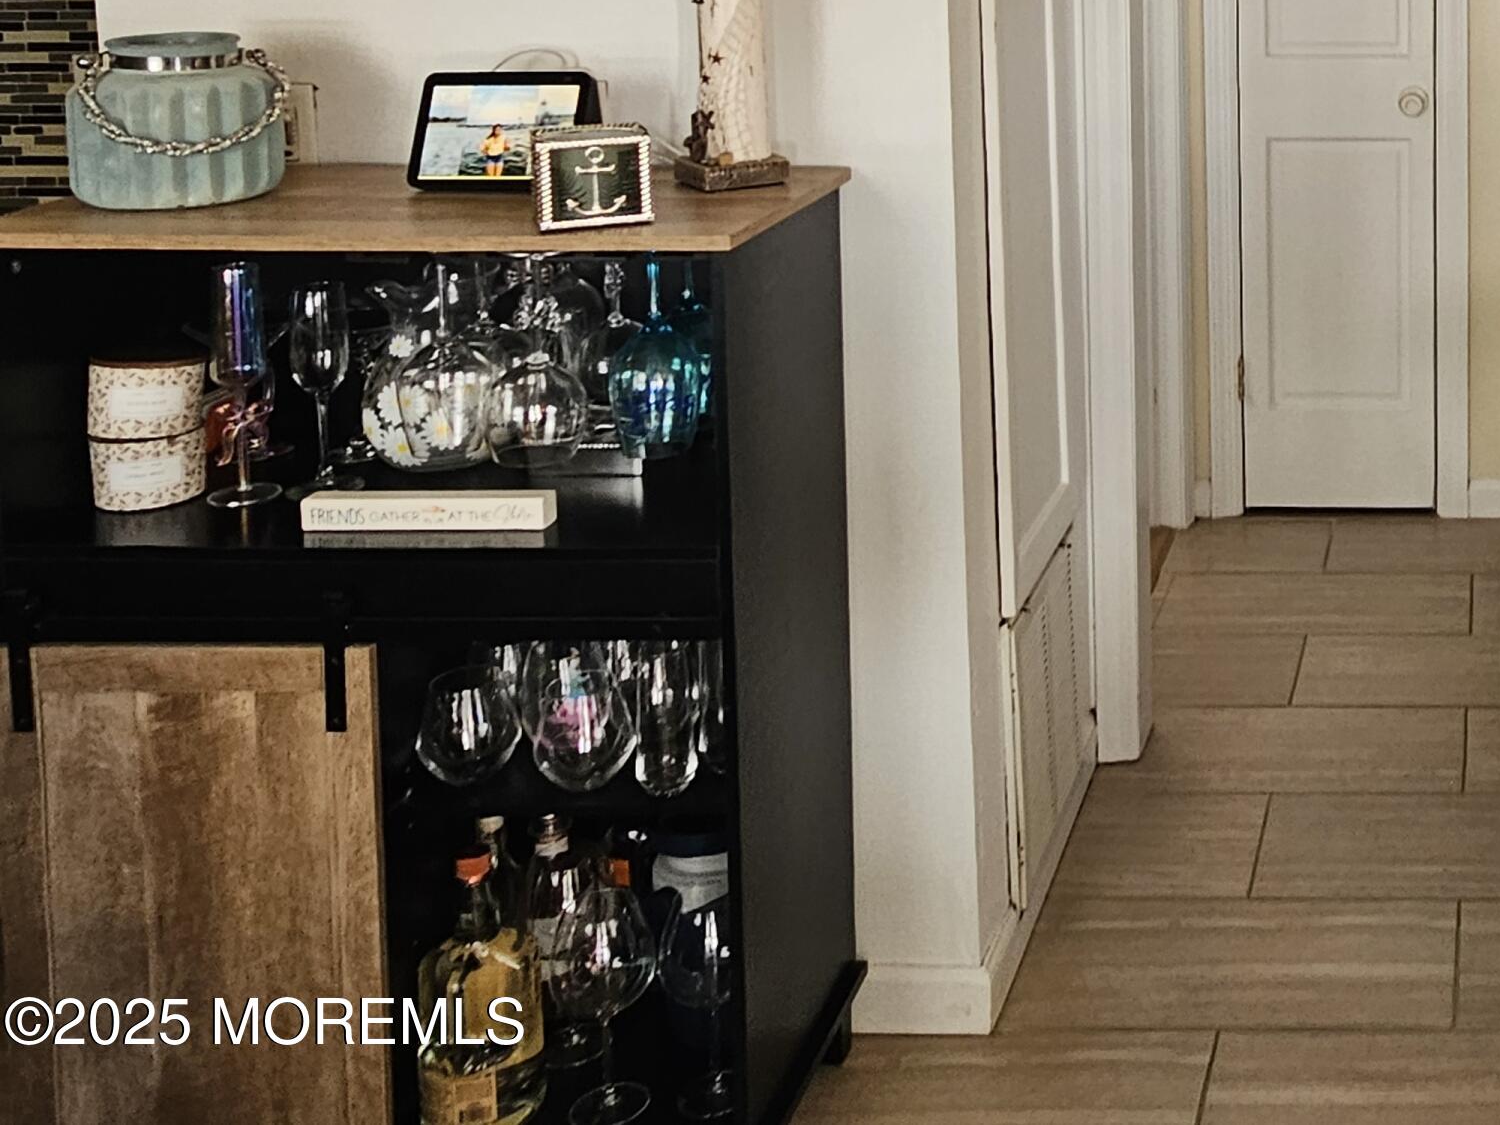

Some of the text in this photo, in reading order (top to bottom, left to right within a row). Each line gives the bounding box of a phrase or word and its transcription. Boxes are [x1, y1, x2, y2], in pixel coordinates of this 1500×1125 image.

[310, 507, 365, 525] FRIENDS
[368, 510, 418, 523] GATHER
[449, 511, 466, 523] AT
[467, 510, 493, 523] THE
